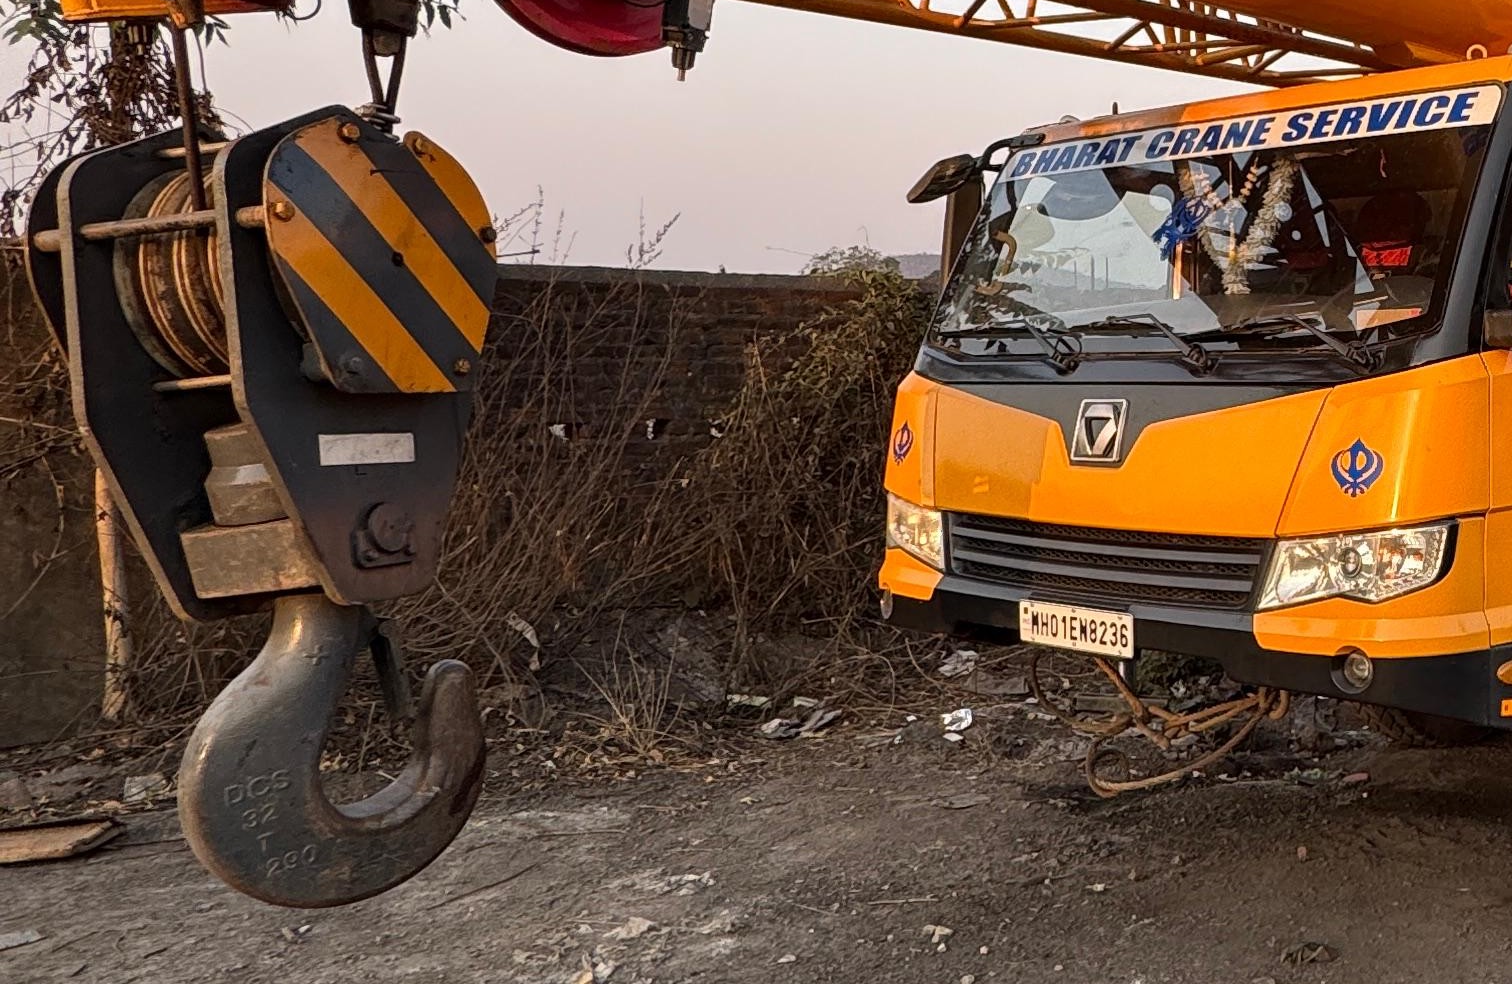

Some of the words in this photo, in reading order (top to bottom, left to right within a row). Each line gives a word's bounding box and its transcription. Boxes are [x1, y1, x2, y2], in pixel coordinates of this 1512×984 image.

[1011, 135, 1143, 177] BHARAT
[1145, 117, 1276, 159] CRANE
[1281, 91, 1480, 143] SERVICE
[223, 769, 290, 807] DCS
[241, 802, 279, 830] 32
